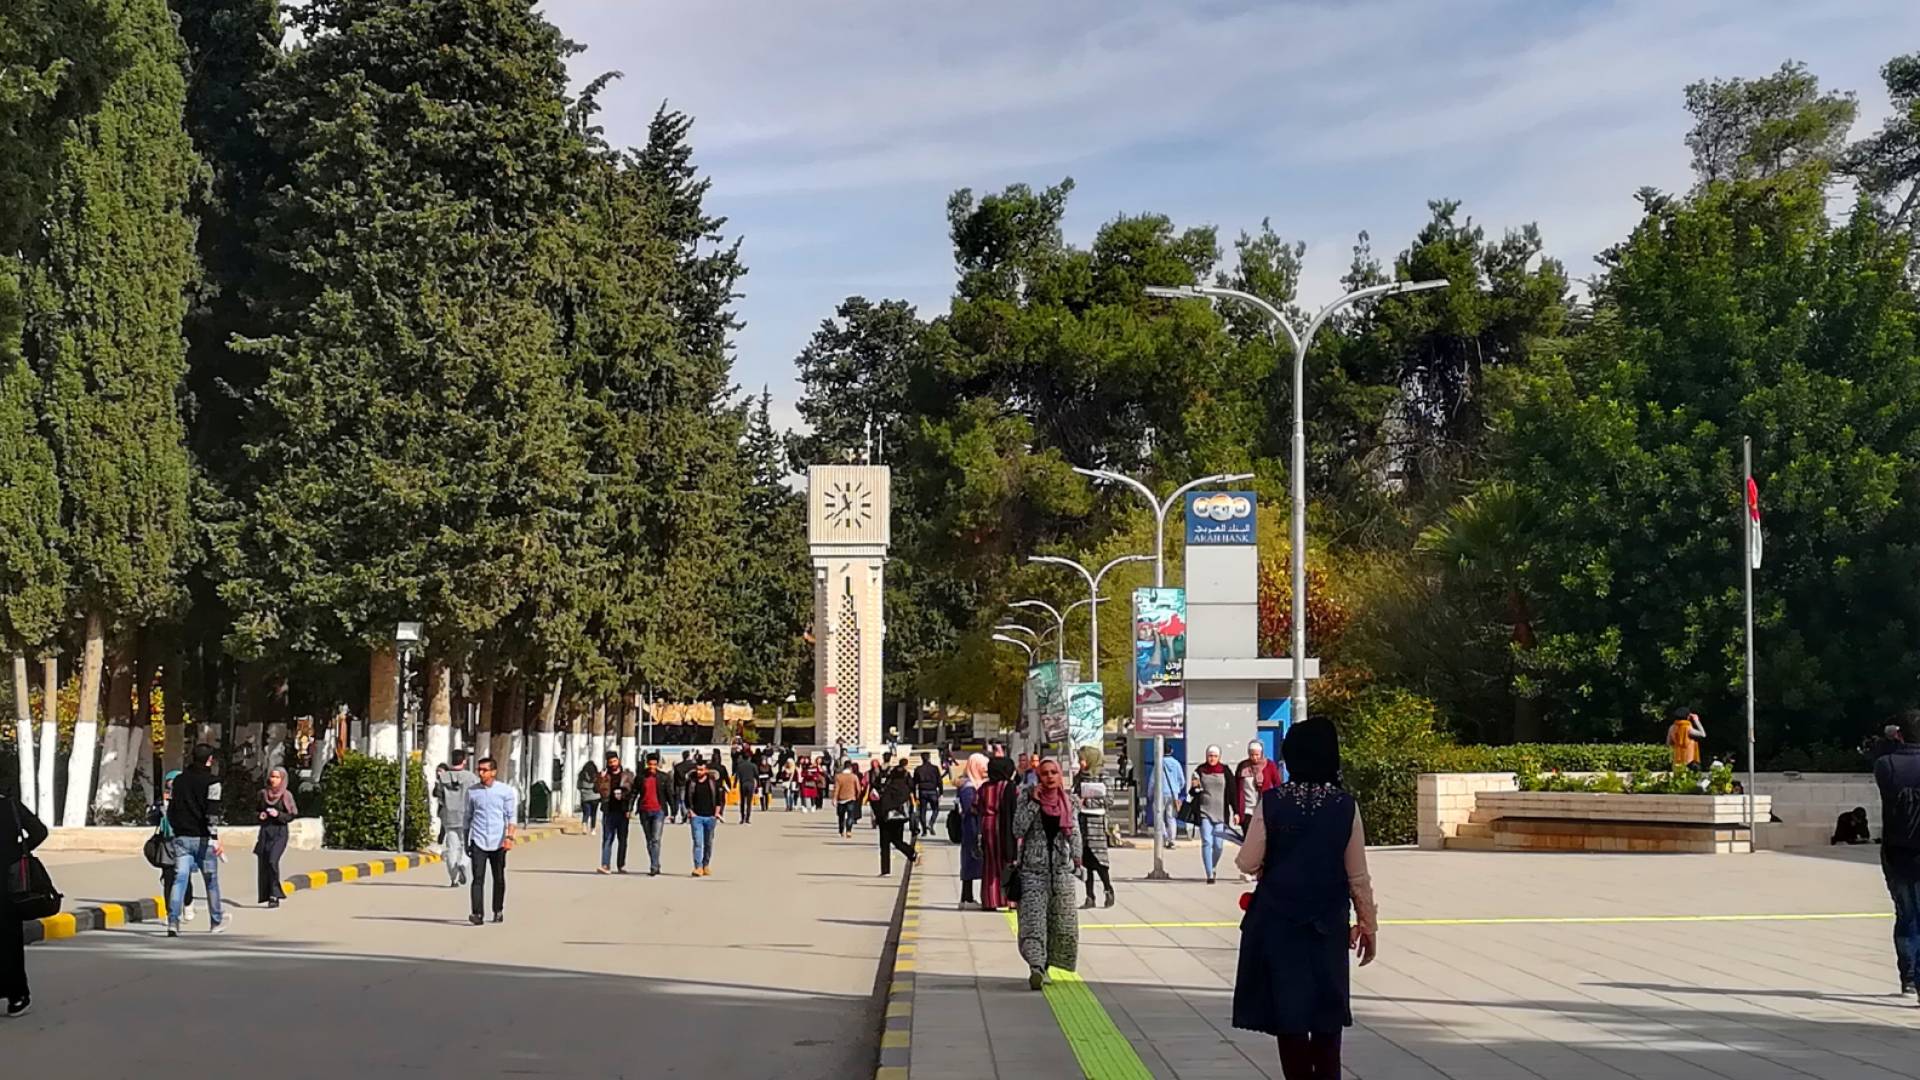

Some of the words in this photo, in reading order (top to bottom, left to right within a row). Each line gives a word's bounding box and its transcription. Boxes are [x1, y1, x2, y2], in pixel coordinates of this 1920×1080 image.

[1227, 523, 1250, 533] البنك
[1194, 534, 1221, 544] ARAB
[1222, 534, 1249, 544] BANK
